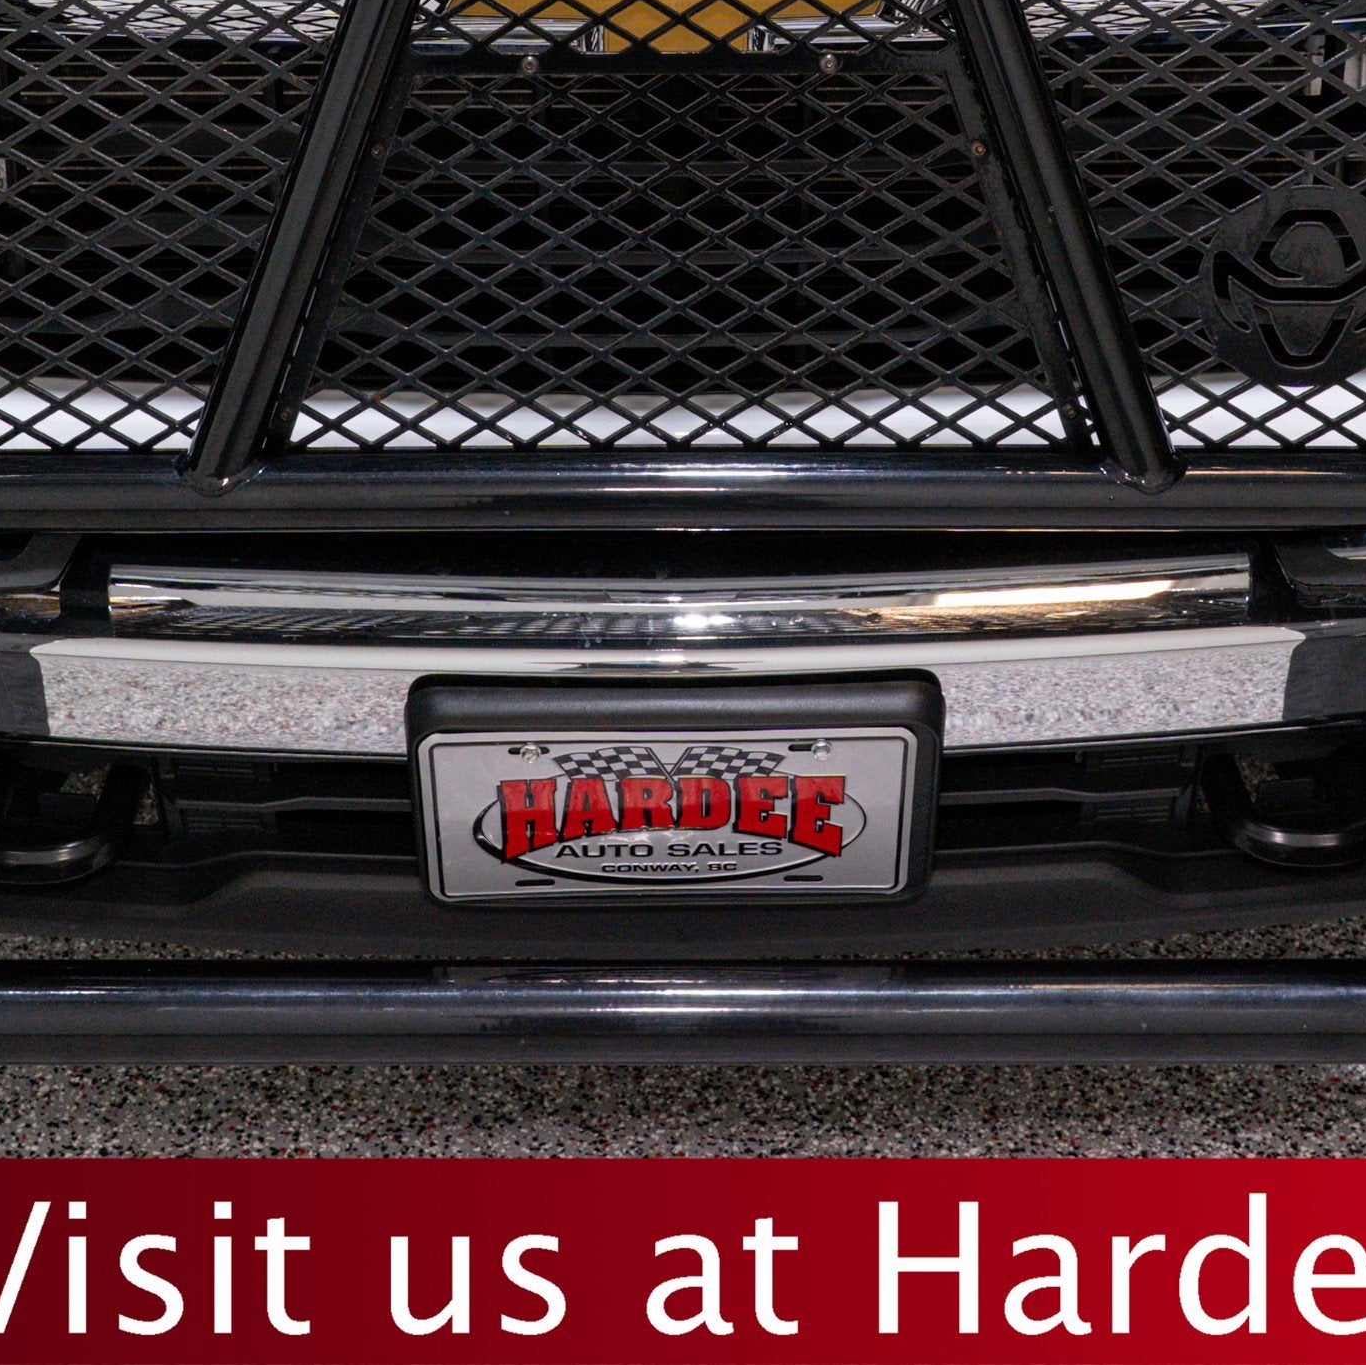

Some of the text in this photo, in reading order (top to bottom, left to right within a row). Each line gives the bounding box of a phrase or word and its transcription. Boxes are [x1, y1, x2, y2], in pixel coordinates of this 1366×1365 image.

[496, 775, 846, 864] HARDEE
[555, 841, 783, 859] AUTO SALES
[601, 861, 738, 874] CONWAY, SC
